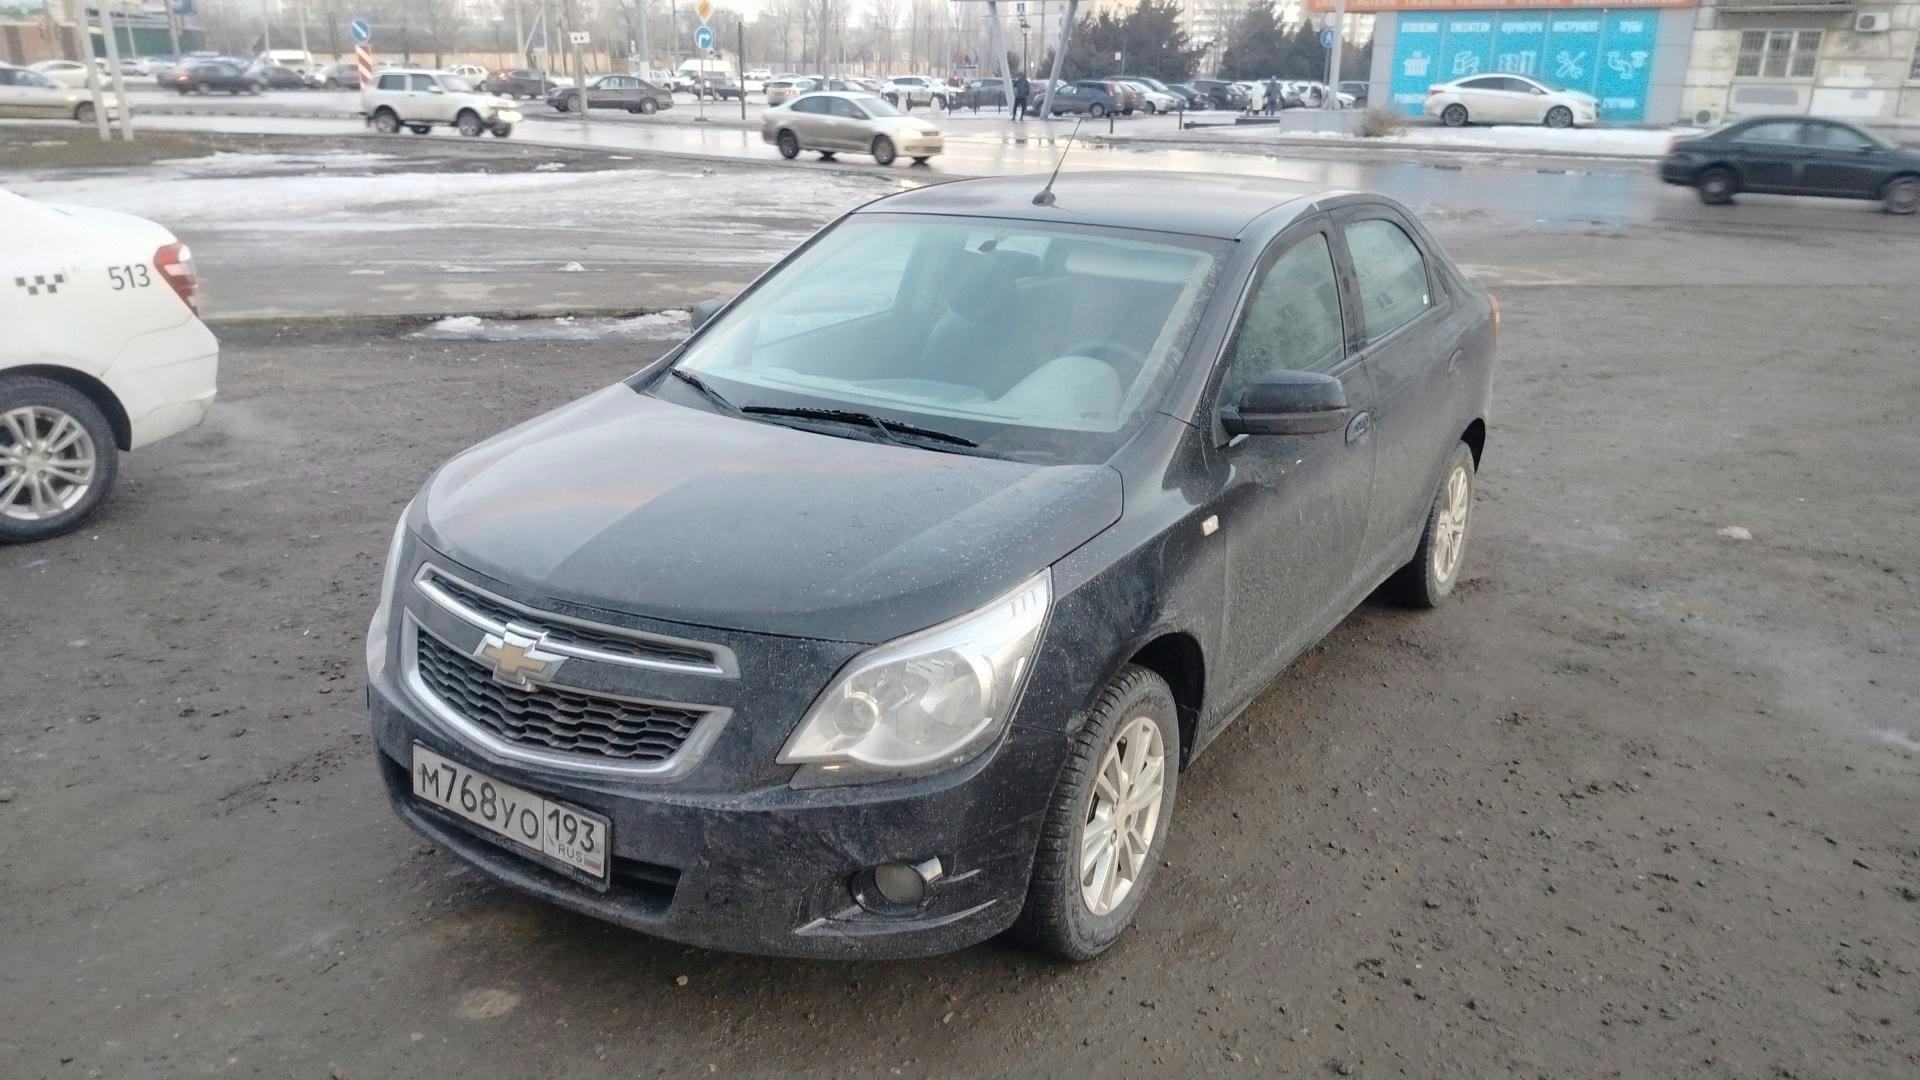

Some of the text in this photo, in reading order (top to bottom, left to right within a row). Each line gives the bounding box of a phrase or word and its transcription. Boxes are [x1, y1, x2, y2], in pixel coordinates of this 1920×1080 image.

[108, 263, 151, 291] 513
[420, 763, 595, 853] М768УО 193
[558, 845, 584, 863] RUS
